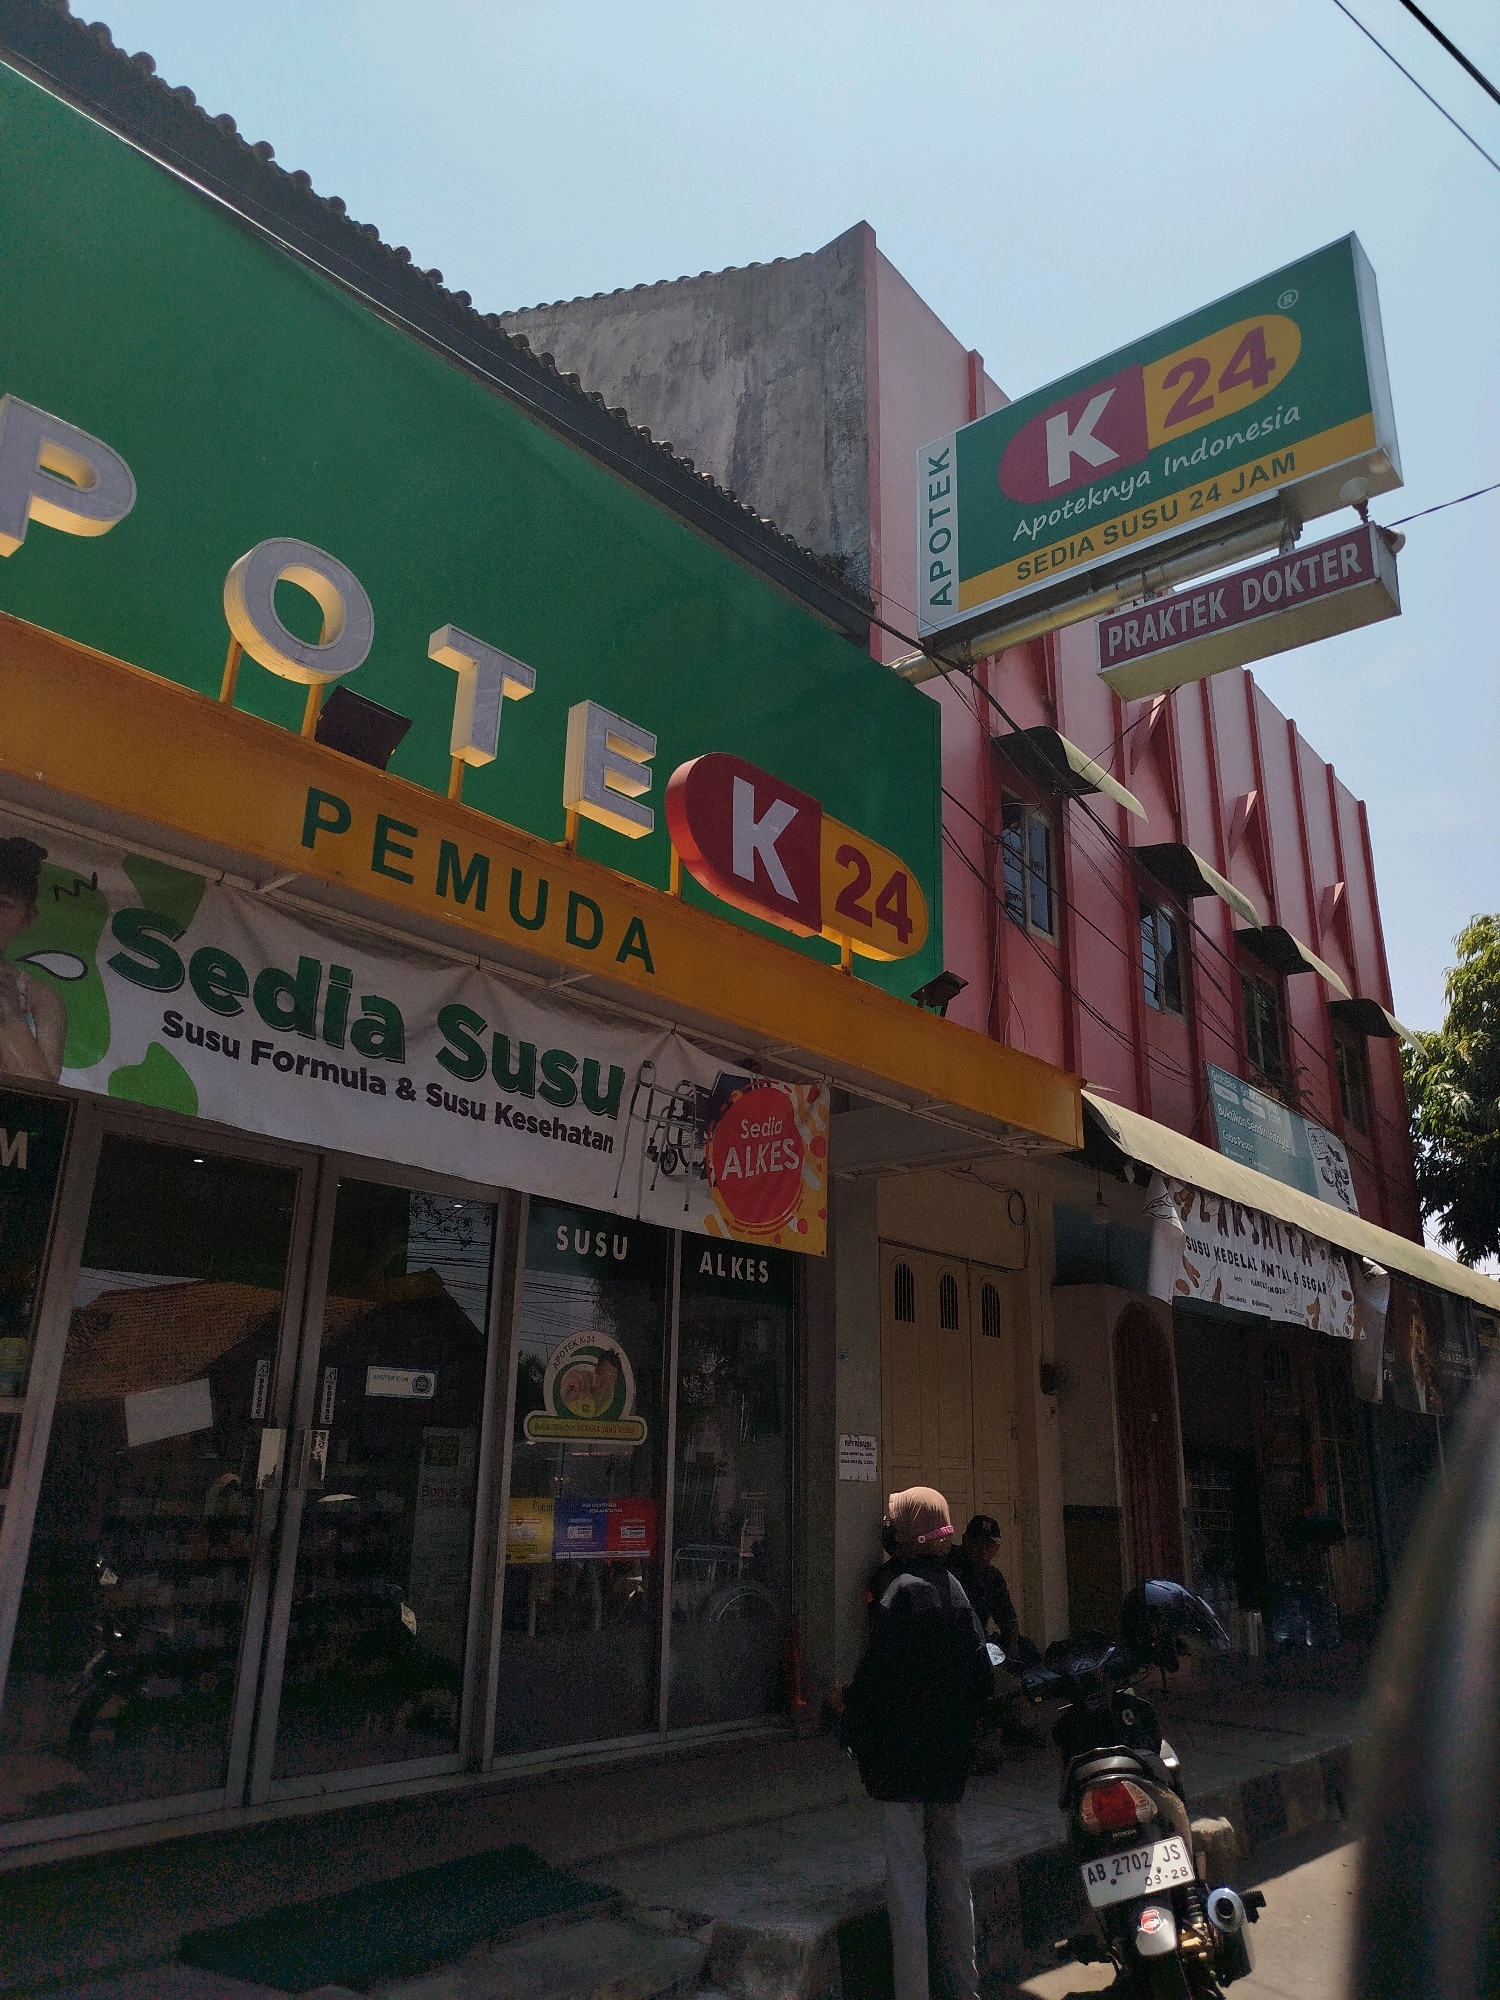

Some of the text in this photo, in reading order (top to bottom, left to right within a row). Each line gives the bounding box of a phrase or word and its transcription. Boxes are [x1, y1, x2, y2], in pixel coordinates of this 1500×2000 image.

[1045, 387, 1119, 488] K
[1160, 325, 1277, 430] 24
[1012, 406, 1301, 542] Apoteknya Indonesia
[1016, 451, 1296, 582] SEDIA SUSU 24 JAM
[928, 446, 952, 607] APOTEK
[1107, 541, 1363, 657] PRAKTEK DOKTER
[301, 786, 656, 975] PEMUDA
[834, 844, 914, 946] 24
[106, 907, 626, 1121] Sedia Susu
[161, 1010, 615, 1155] Susu Formula & Susu Kesehatan
[740, 1116, 783, 1140] Sedia
[721, 1138, 801, 1182] ALKES
[555, 1225, 629, 1261] SUSU
[700, 1251, 769, 1284] ALKES
[1185, 1236, 1211, 1258] SUSU
[1213, 1245, 1258, 1271] KEDELAI
[1301, 1274, 1328, 1296] SEGAR
[553, 1338, 579, 1370] APOTEK
[1087, 1843, 1181, 1885] AB 2702 JS
[1112, 1829, 1137, 1839] HONDA
